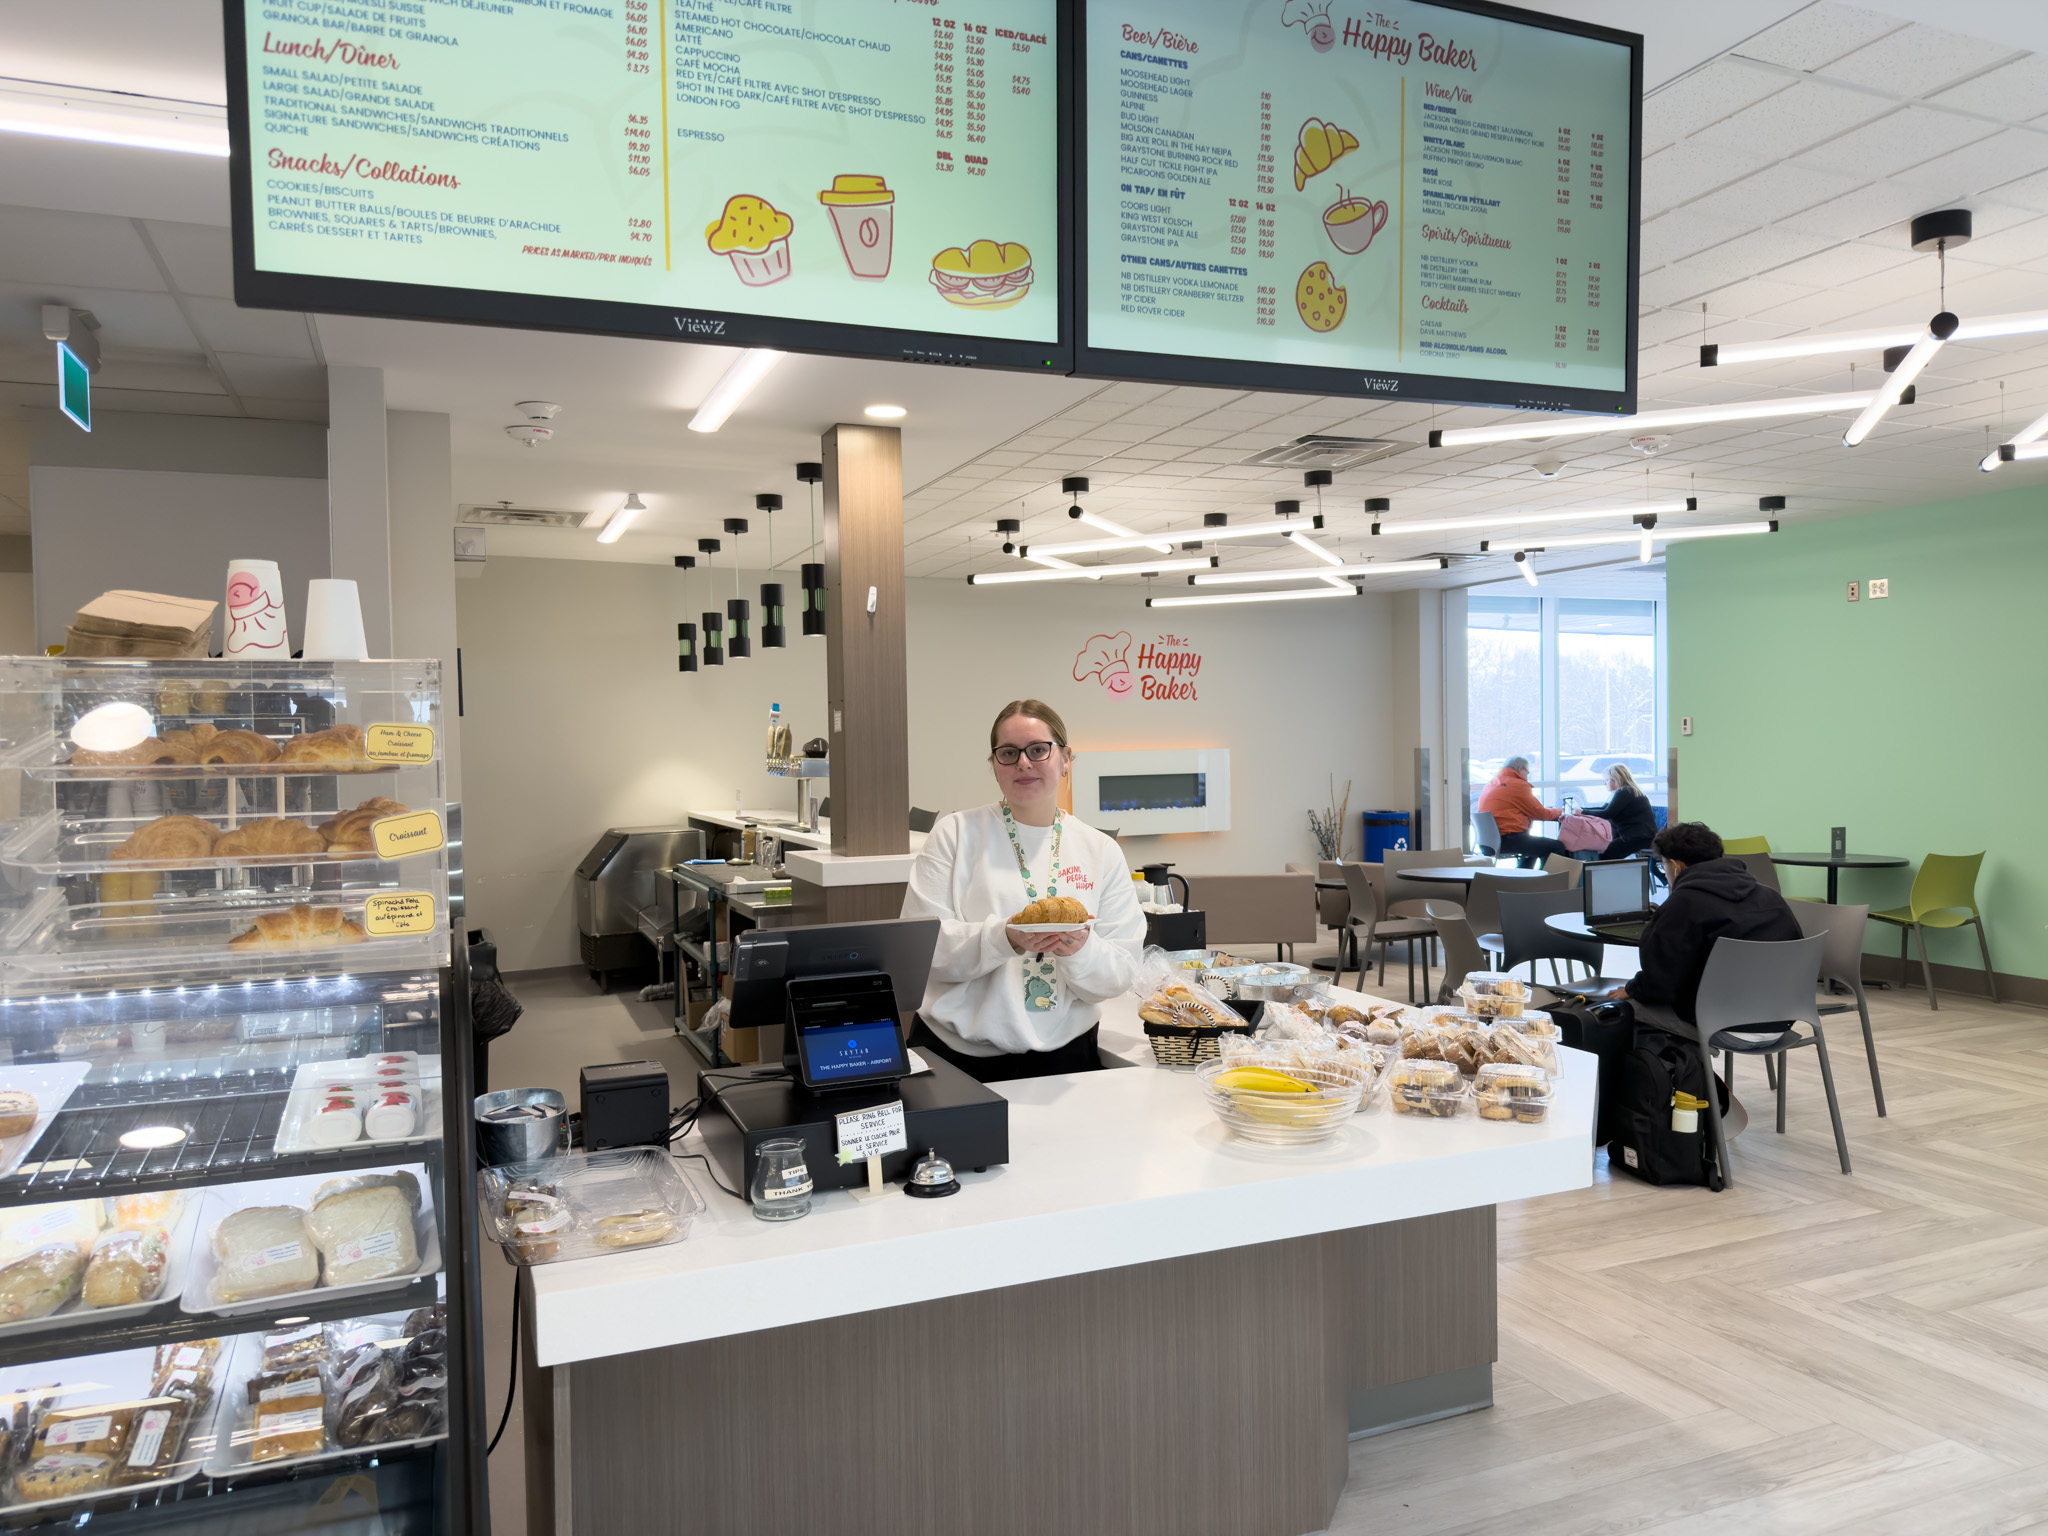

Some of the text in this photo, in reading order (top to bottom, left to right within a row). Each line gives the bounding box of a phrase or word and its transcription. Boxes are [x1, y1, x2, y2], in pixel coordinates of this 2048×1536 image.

[563, 3, 613, 18] FROMAGE
[765, 1, 792, 14] FILTRE
[262, 9, 459, 47] GRANOLA BAR/BARRE DE GRANOLA
[674, 9, 891, 52] STEAMED HOT CHOCOLATE/CHOCOLAT CHAUD
[675, 22, 733, 39] AMERICANO
[932, 17, 955, 29] 12 OZ
[964, 23, 987, 34] 16 OZ
[995, 28, 1047, 44] ICED/GLACÉ
[1122, 24, 1199, 53] Beer/Bière
[1343, 13, 1477, 72] The Happy Baker
[263, 31, 400, 70] Lunch/Dîner
[676, 45, 740, 63] CAPPUCCINO
[675, 56, 740, 76] CAFÉ MOCHA
[1120, 50, 1188, 70] CANS/CANETTES
[262, 65, 423, 95] SMALL SALAD/PETITE SALADE
[1120, 69, 1190, 87] MOOSEHEAD LIGHT
[262, 80, 435, 111] LARGE SALAD/GRANDE SALADE
[675, 68, 881, 107] RED EYE/CAFÉ FILTRE AVEC SHOT D'ESPRESSO
[1120, 80, 1193, 98] MOOSEHEAD LAGER
[1120, 89, 1158, 102] GUINNESS
[1425, 81, 1473, 103] Wine/Vin
[676, 93, 740, 109] LONDON FOG
[1120, 100, 1145, 112] ALPINE
[264, 96, 569, 142] TRADITIONAL SANDWICHES/SANDWICHS TRADITIONNELS
[1120, 113, 1159, 125] BUD LIGHT
[264, 122, 310, 136] QUICHE
[264, 108, 540, 151] SIGNATURE SANDWICHES/SANDWICHS CRÉATIONS
[678, 128, 724, 142] ESPRESSO
[1120, 134, 1134, 143] BIG
[1135, 136, 1149, 145] AXE
[1151, 138, 1168, 148] ROLL
[1171, 141, 1178, 149] IN
[1181, 142, 1193, 151] THE
[1195, 144, 1210, 154] HAY
[936, 150, 953, 161] DBL
[965, 154, 988, 165] QUAD
[268, 148, 461, 189] Snacks/Collations
[628, 166, 650, 176] $6.05
[266, 180, 374, 199] COOKIES/BISCUITS
[1120, 184, 1132, 193] ON
[1134, 186, 1155, 196] TAP/
[1157, 188, 1168, 198] EN
[267, 194, 560, 233] PEANUT BUTTER BALLS/BOULES DE BEURRE D'ARACHIDE
[1120, 202, 1171, 214] COORS LIGHT
[628, 218, 652, 228] $2.80
[268, 220, 422, 244] CARRÉS DESSERT ET TARTES
[1422, 224, 1512, 250] Spirits/Spiritueux
[522, 245, 550, 256] PRICES
[1120, 254, 1248, 276] OTHER CANS/AUTRES CANETTES
[1120, 272, 1238, 292] NB DISTILLERY VODKA LEMONADE
[1120, 305, 1185, 318] RED ROVER CIDER
[1422, 294, 1469, 313] Cocktails
[1166, 634, 1181, 646] The
[1138, 644, 1201, 677] Happy
[1140, 674, 1198, 701] Baker
[389, 827, 428, 841] Croissant
[1066, 874, 1087, 884] PEOPLE
[840, 1048, 868, 1056] SKYTAB
[839, 1106, 902, 1125] PLEASE RING BELL FOR
[861, 1119, 885, 1130] SERVICE
[841, 1137, 863, 1146] SONNER
[871, 1132, 888, 1140] CLOCHE
[856, 1140, 888, 1152] LE SERVICE
[788, 1168, 804, 1176] TIPS
[773, 1187, 803, 1196] THANK
